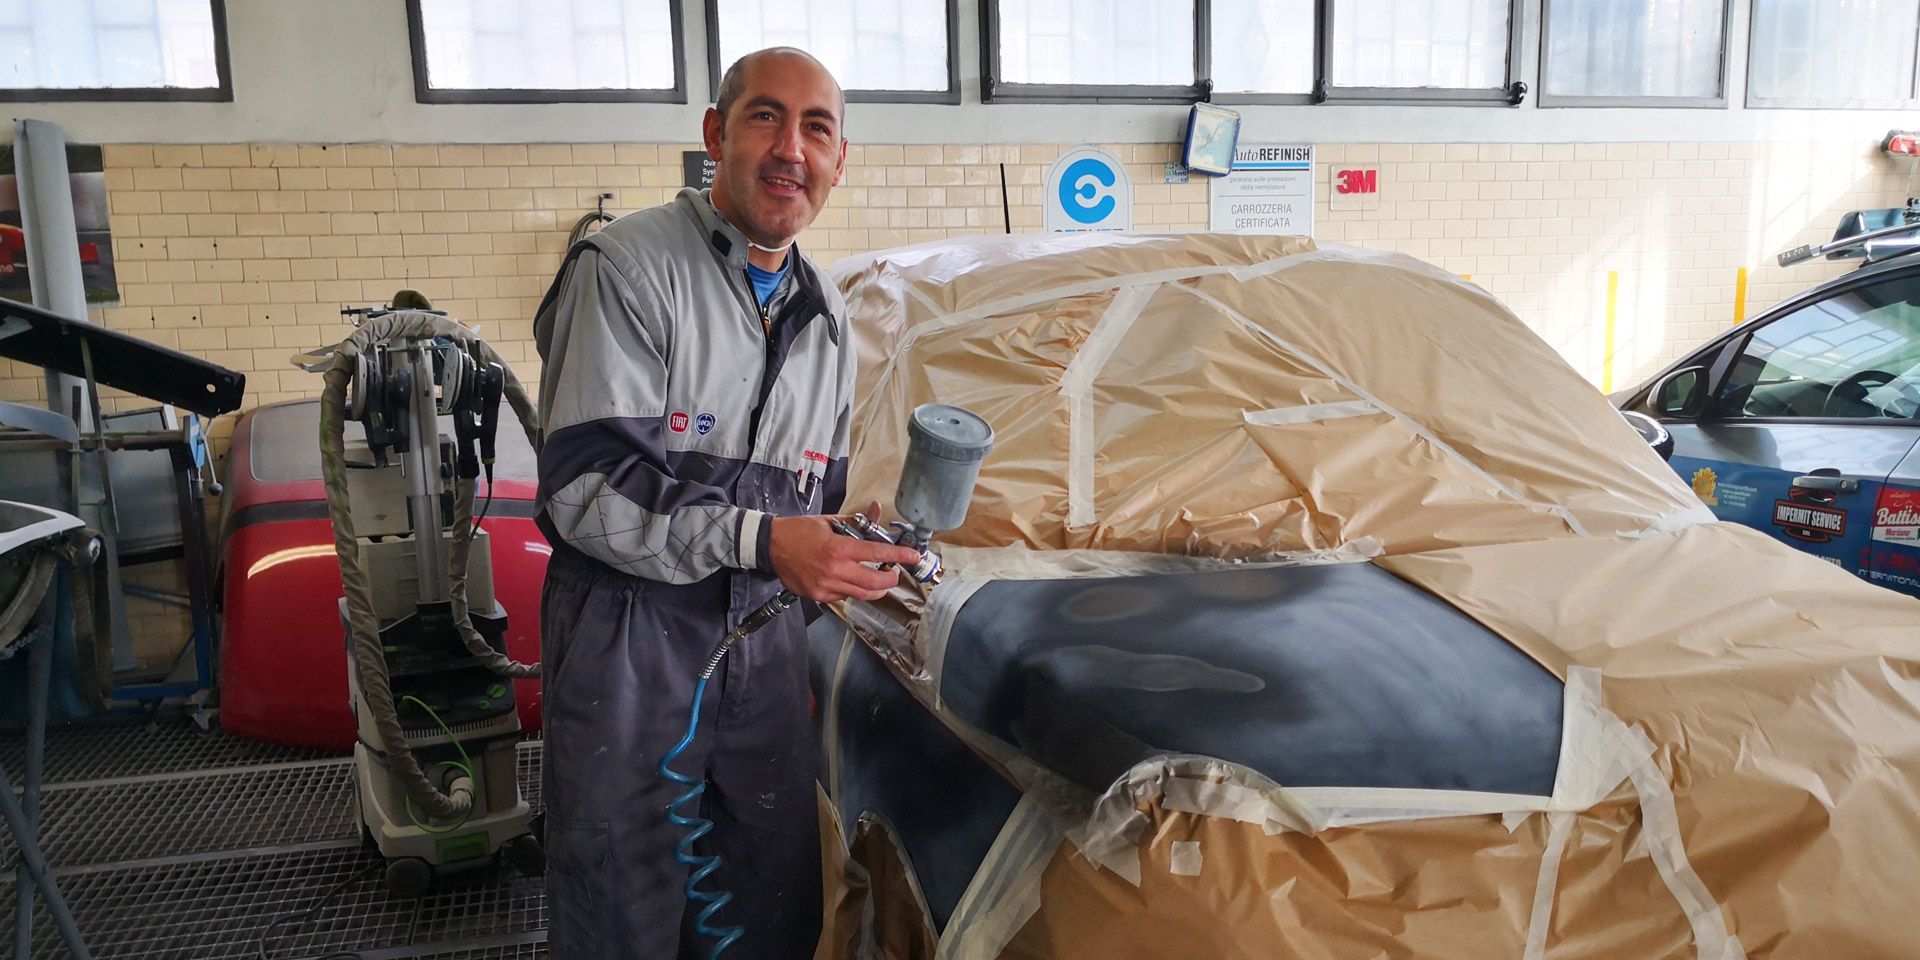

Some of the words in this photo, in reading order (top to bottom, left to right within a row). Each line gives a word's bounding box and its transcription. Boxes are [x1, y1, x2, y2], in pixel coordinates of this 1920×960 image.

[1336, 170, 1376, 194] 3M
[1231, 203, 1292, 214] CARROZZERIA
[1235, 218, 1290, 228] CERTIFICATA
[672, 415, 688, 429] FIAT
[1776, 505, 1812, 526] IMPERMIT
[1811, 510, 1842, 531] SERVICE
